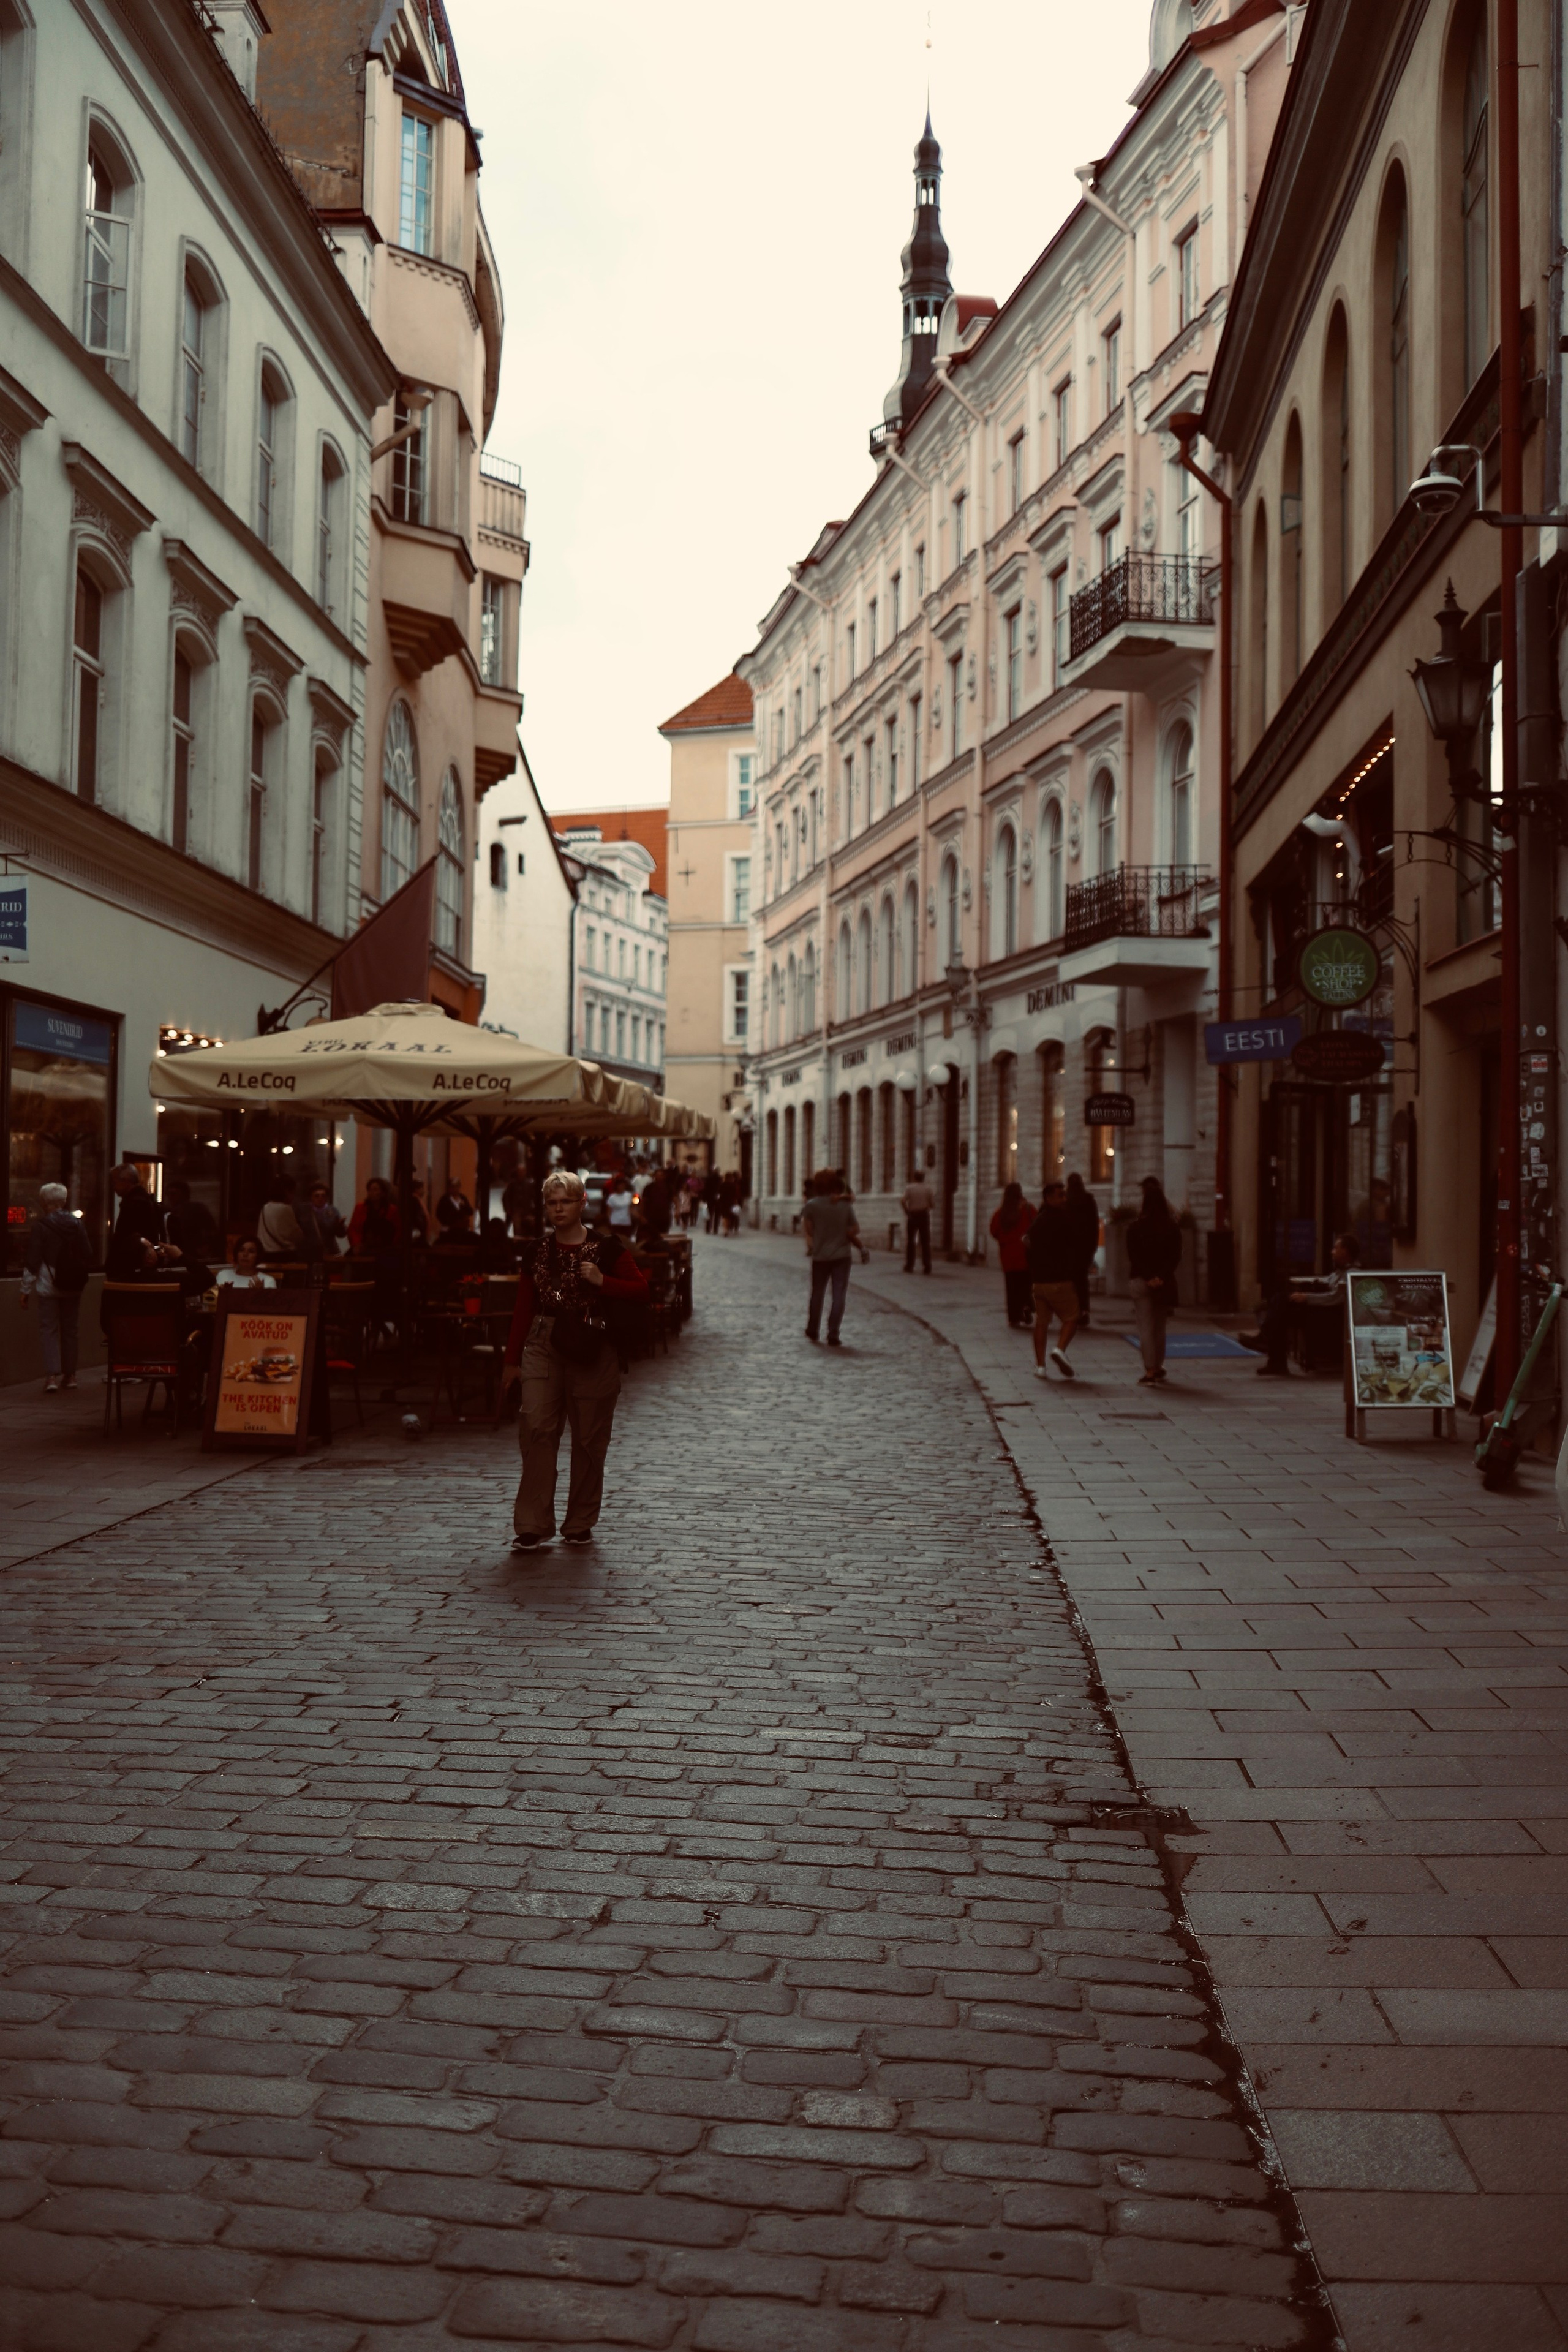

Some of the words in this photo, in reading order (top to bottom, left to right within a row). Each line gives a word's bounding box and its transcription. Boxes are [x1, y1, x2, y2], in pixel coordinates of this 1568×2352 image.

[1312, 965, 1365, 978] COFFEE
[1322, 979, 1355, 990] SHOP
[1322, 990, 1357, 1000] TALLINN
[47, 1017, 83, 1040] SUVENIIRID
[1224, 1028, 1284, 1052] EESTI
[296, 1041, 453, 1053] LOKAAL
[241, 1320, 273, 1330] KÖÖK
[276, 1322, 293, 1330] ON
[243, 1330, 288, 1340] AVATUD
[222, 1393, 244, 1403] THE
[248, 1395, 296, 1405] KITCHEN
[236, 1403, 246, 1412] IS
[250, 1404, 281, 1413] OPEN
